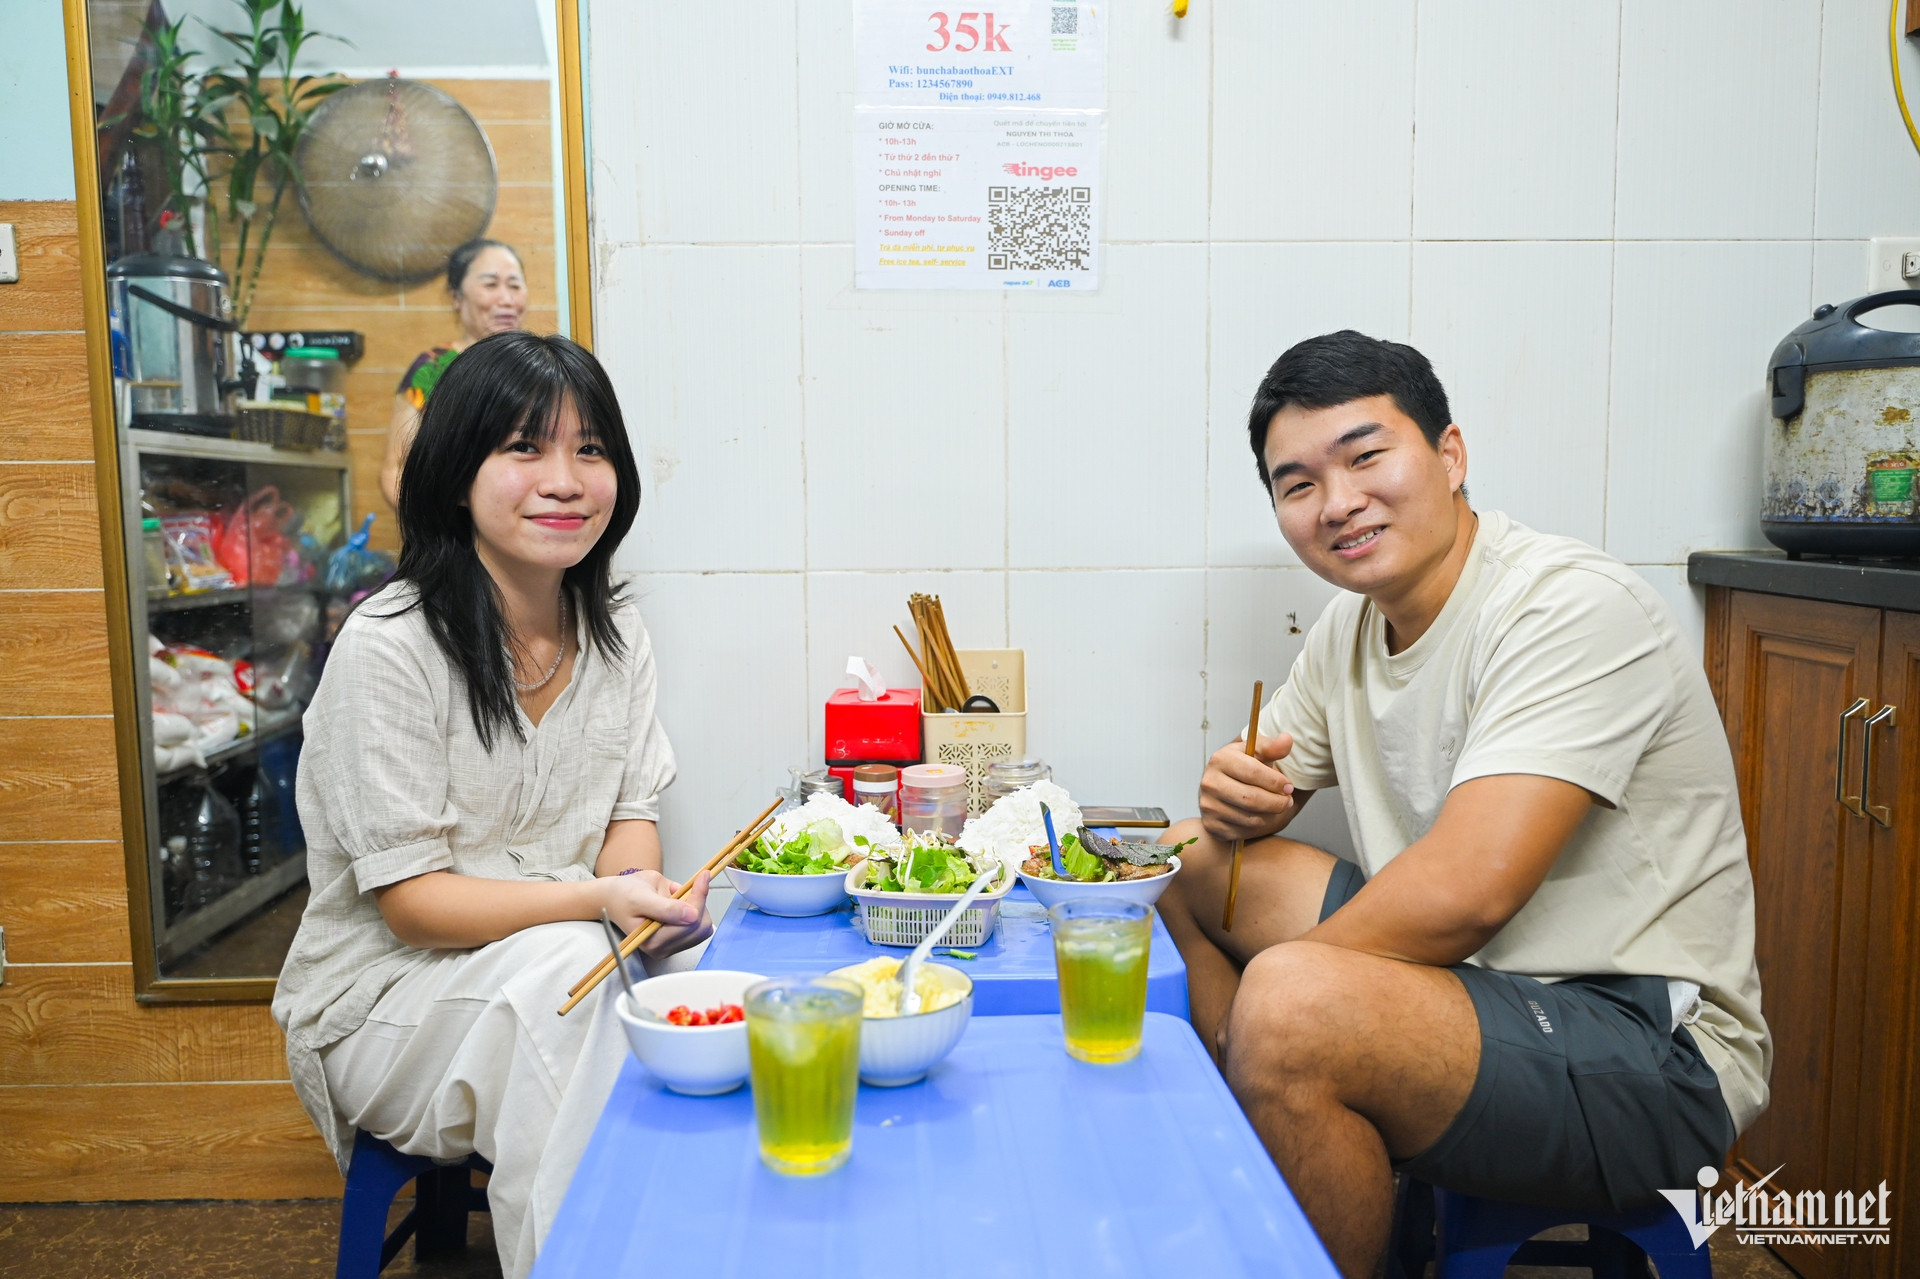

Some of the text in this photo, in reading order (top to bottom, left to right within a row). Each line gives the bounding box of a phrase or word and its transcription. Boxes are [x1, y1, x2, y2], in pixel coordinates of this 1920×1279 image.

[926, 11, 1012, 52] 35k
[888, 65, 1015, 76] Wifi: bunchabaothoaEXT
[888, 79, 973, 88] Pass: 1234567890
[939, 92, 1041, 102] Điện thoại: 0949.812.468
[878, 120, 934, 129] GIỜ MỞ CỬA:
[884, 153, 896, 161] Từ
[898, 153, 912, 161] thứ
[939, 153, 953, 161] thứ
[884, 168, 900, 176] Chủ
[903, 168, 921, 178] nhật
[1012, 161, 1078, 181] tingee
[878, 184, 941, 192] OPENING TIME:
[884, 199, 916, 207] 10h- 13h
[884, 214, 904, 222] From
[906, 214, 936, 223] Monday
[947, 214, 982, 223] Saturday
[884, 229, 912, 238] Sunday
[879, 257, 895, 266] Free
[896, 257, 907, 266] ice
[940, 258, 966, 266] service
[1048, 279, 1071, 287] ACB
